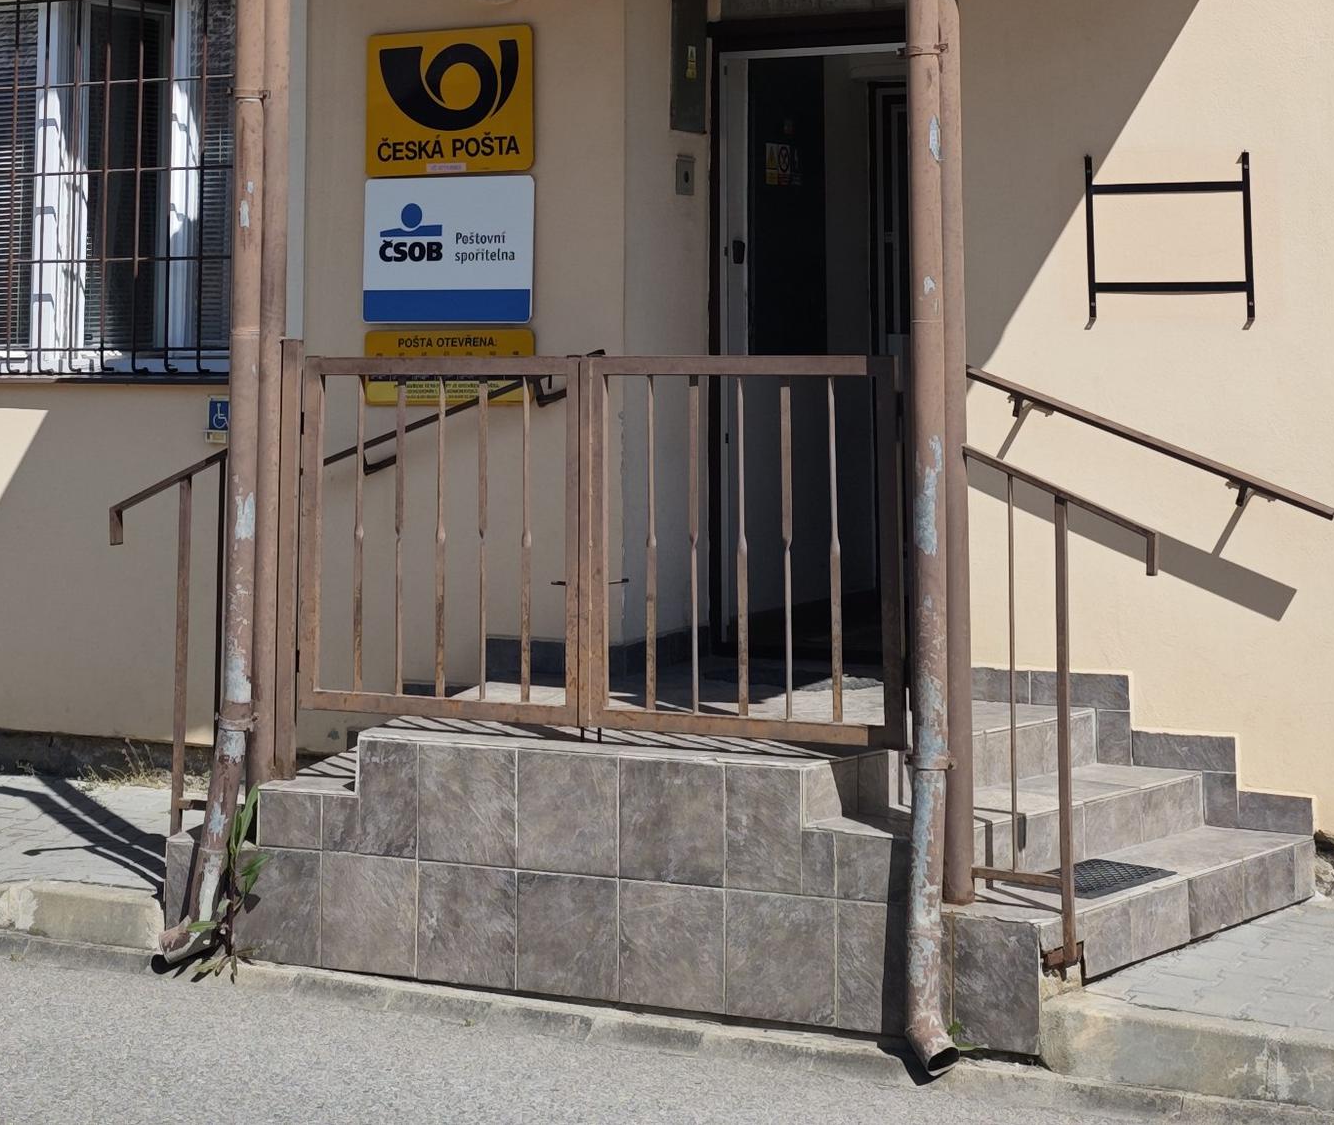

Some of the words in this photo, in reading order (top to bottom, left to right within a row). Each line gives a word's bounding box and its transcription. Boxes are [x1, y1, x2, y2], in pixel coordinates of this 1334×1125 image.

[377, 134, 444, 162] ČESKÁ
[451, 131, 520, 158] POŠTA
[455, 231, 506, 245] Poštovní
[378, 239, 443, 263] ČSOB
[454, 248, 515, 264] spořitelna
[397, 335, 434, 348] POŠTA
[436, 334, 497, 348] OTEVŘENA:
